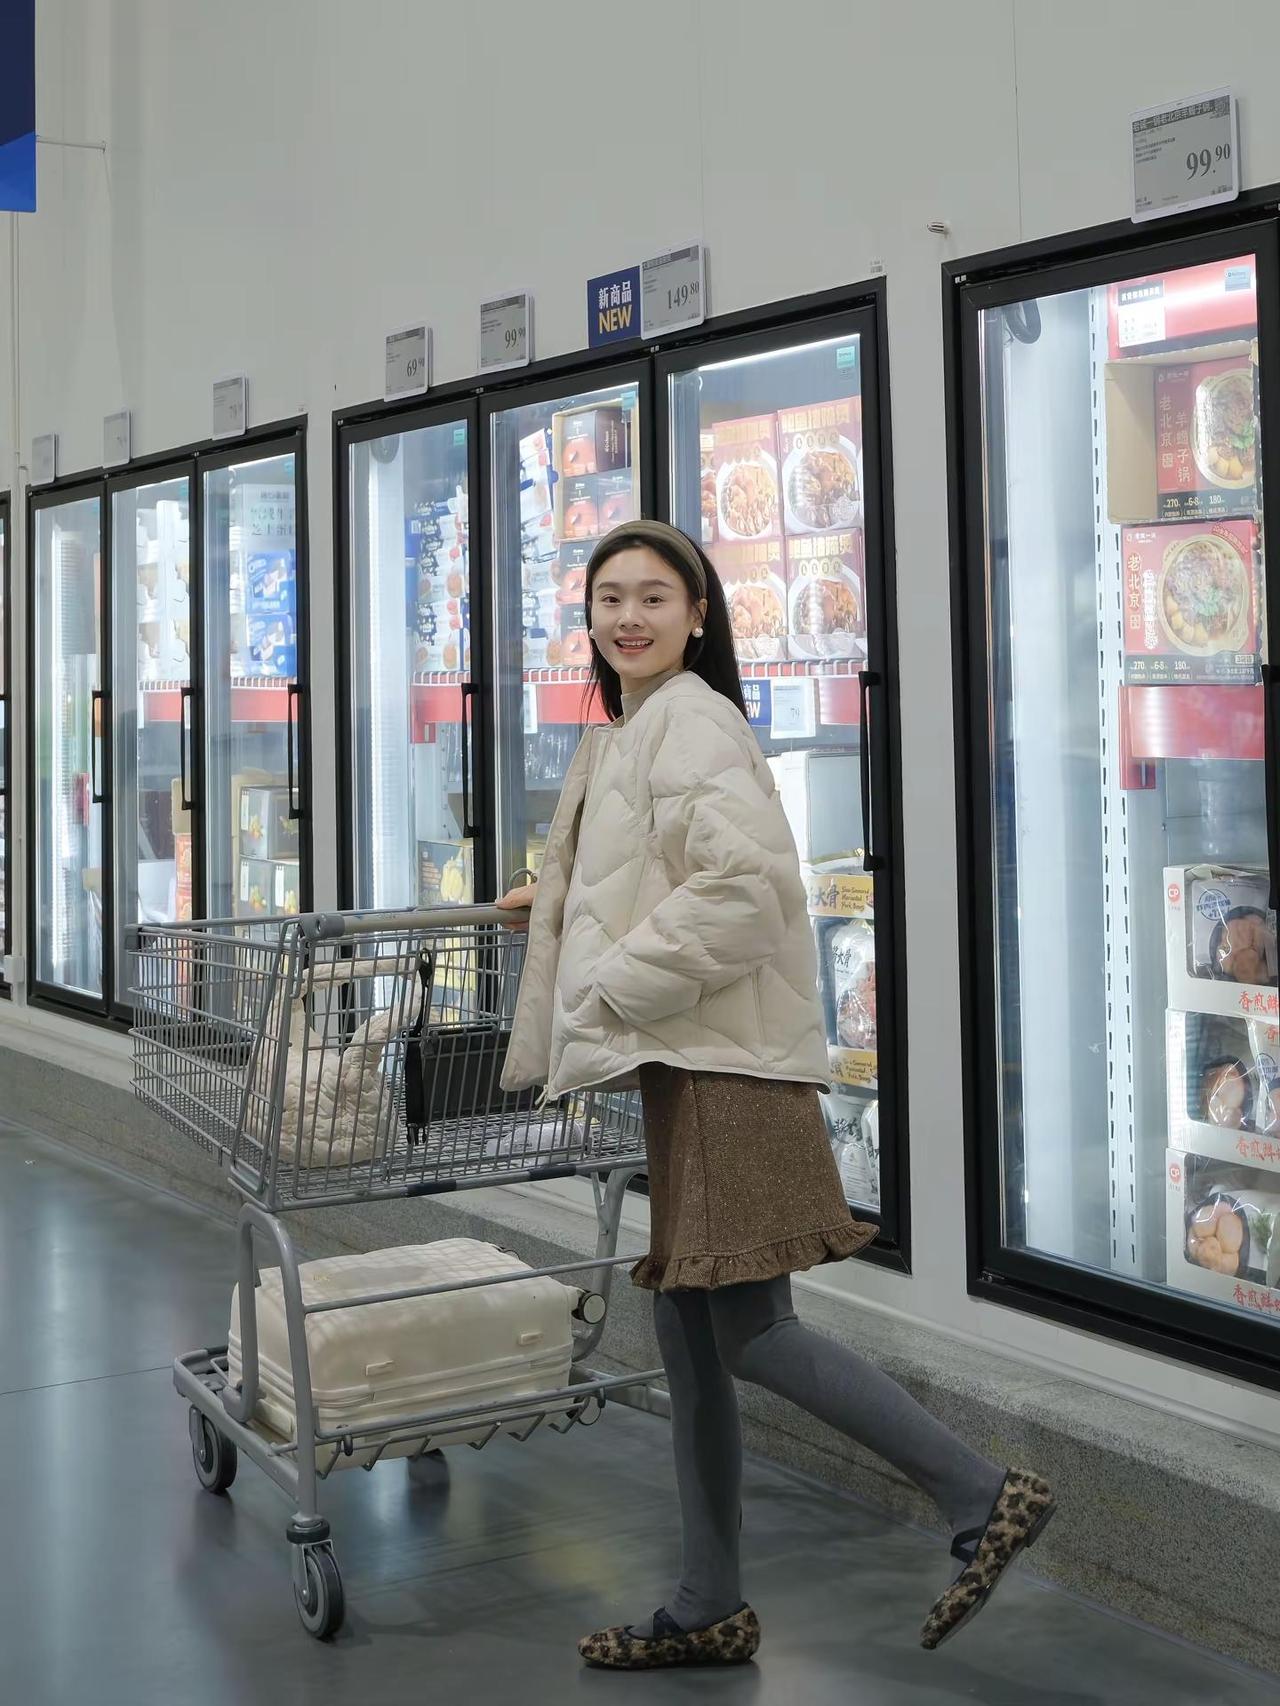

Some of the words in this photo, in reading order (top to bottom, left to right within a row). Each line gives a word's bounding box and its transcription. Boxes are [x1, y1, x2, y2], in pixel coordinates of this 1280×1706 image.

[1186, 143, 1231, 181] 99.90
[598, 280, 632, 309] 新商品
[667, 280, 700, 310] 149.80
[599, 304, 632, 334] NEW
[1127, 552, 1141, 608] 老北京
